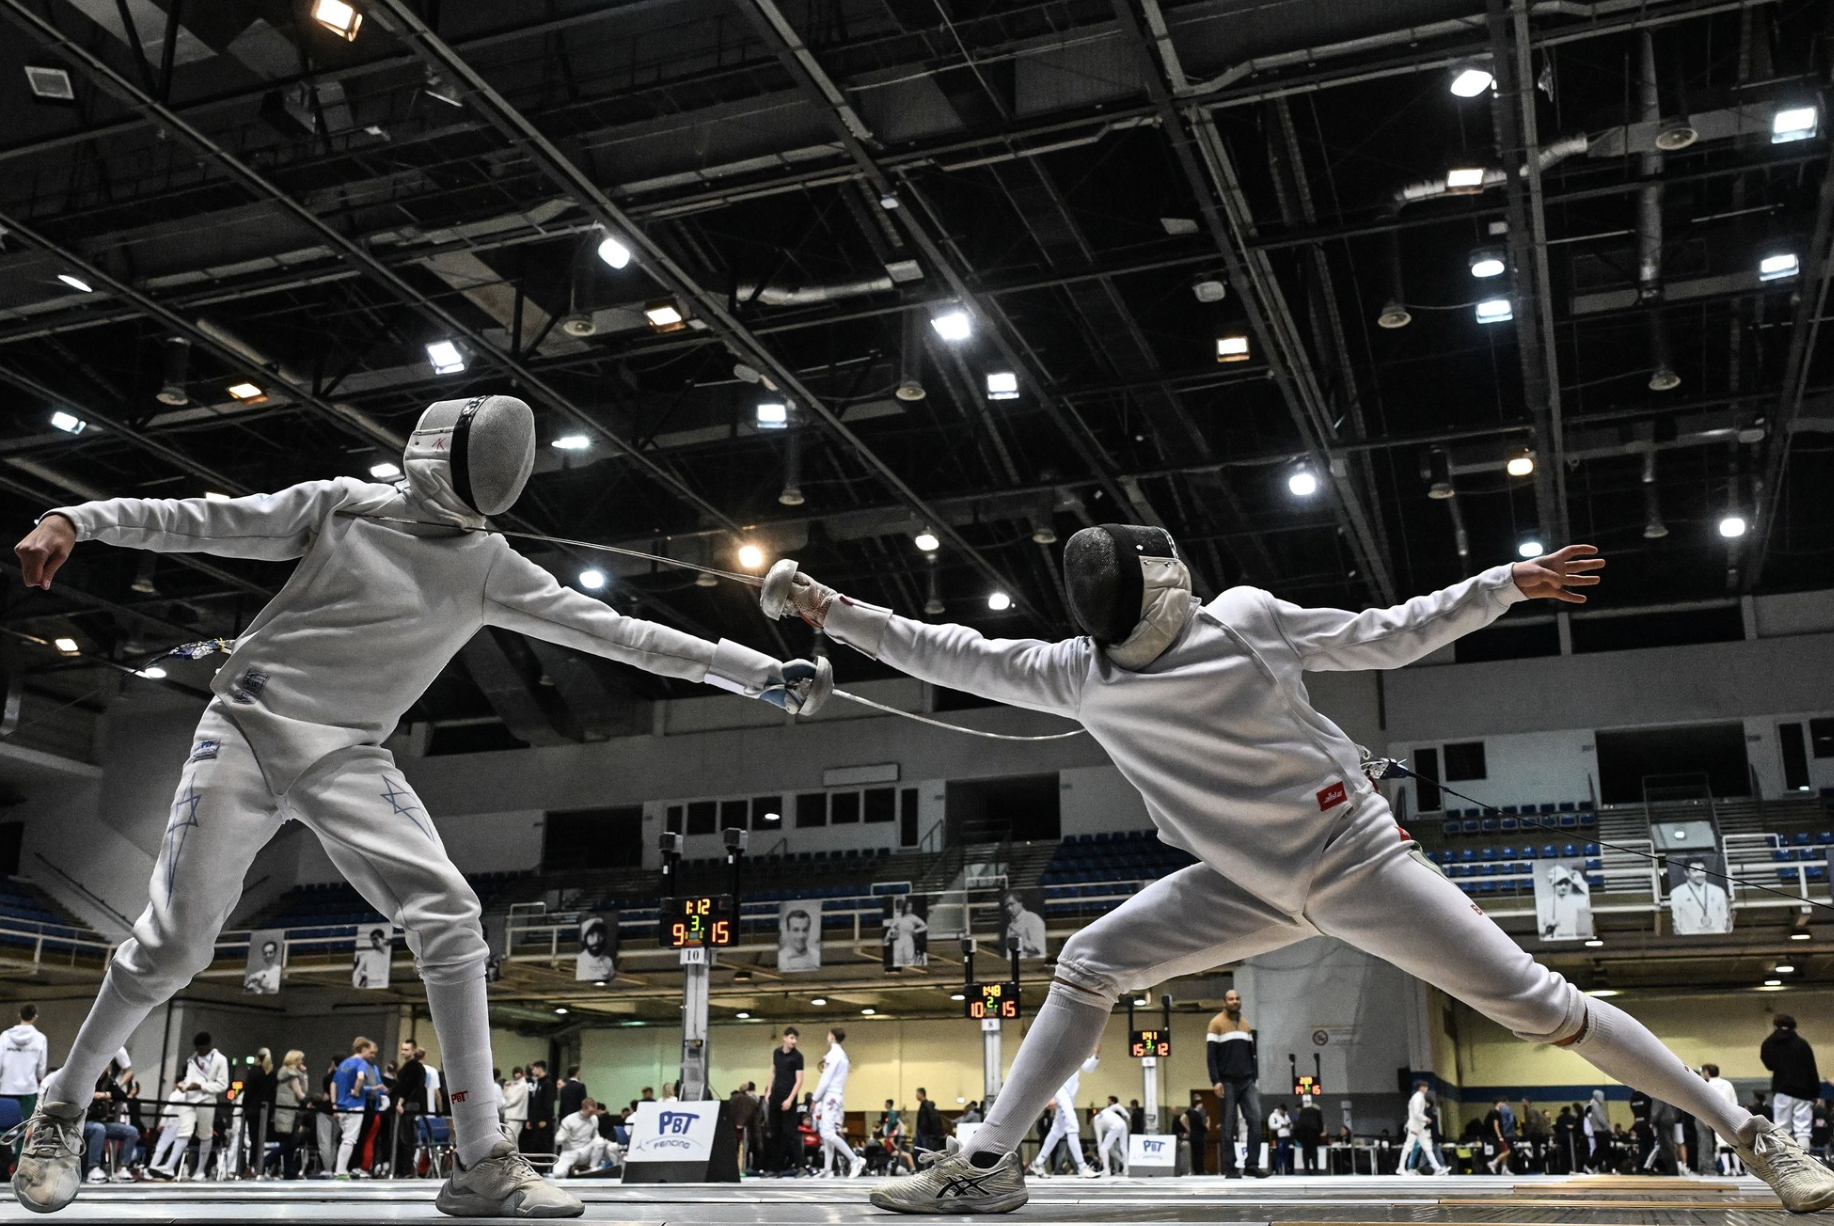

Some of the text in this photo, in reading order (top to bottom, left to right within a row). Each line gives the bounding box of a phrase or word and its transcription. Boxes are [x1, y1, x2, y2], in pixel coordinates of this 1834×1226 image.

[685, 898, 711, 915] 1:12
[672, 921, 729, 945] 9 15
[686, 950, 700, 961] 10
[982, 984, 1001, 997] 1:48
[970, 1000, 1016, 1018] 10 15
[1132, 1042, 1169, 1057] 15 12
[451, 1090, 468, 1105] PBT
[659, 1111, 700, 1135] PBT
[1143, 1140, 1166, 1152] PBT
